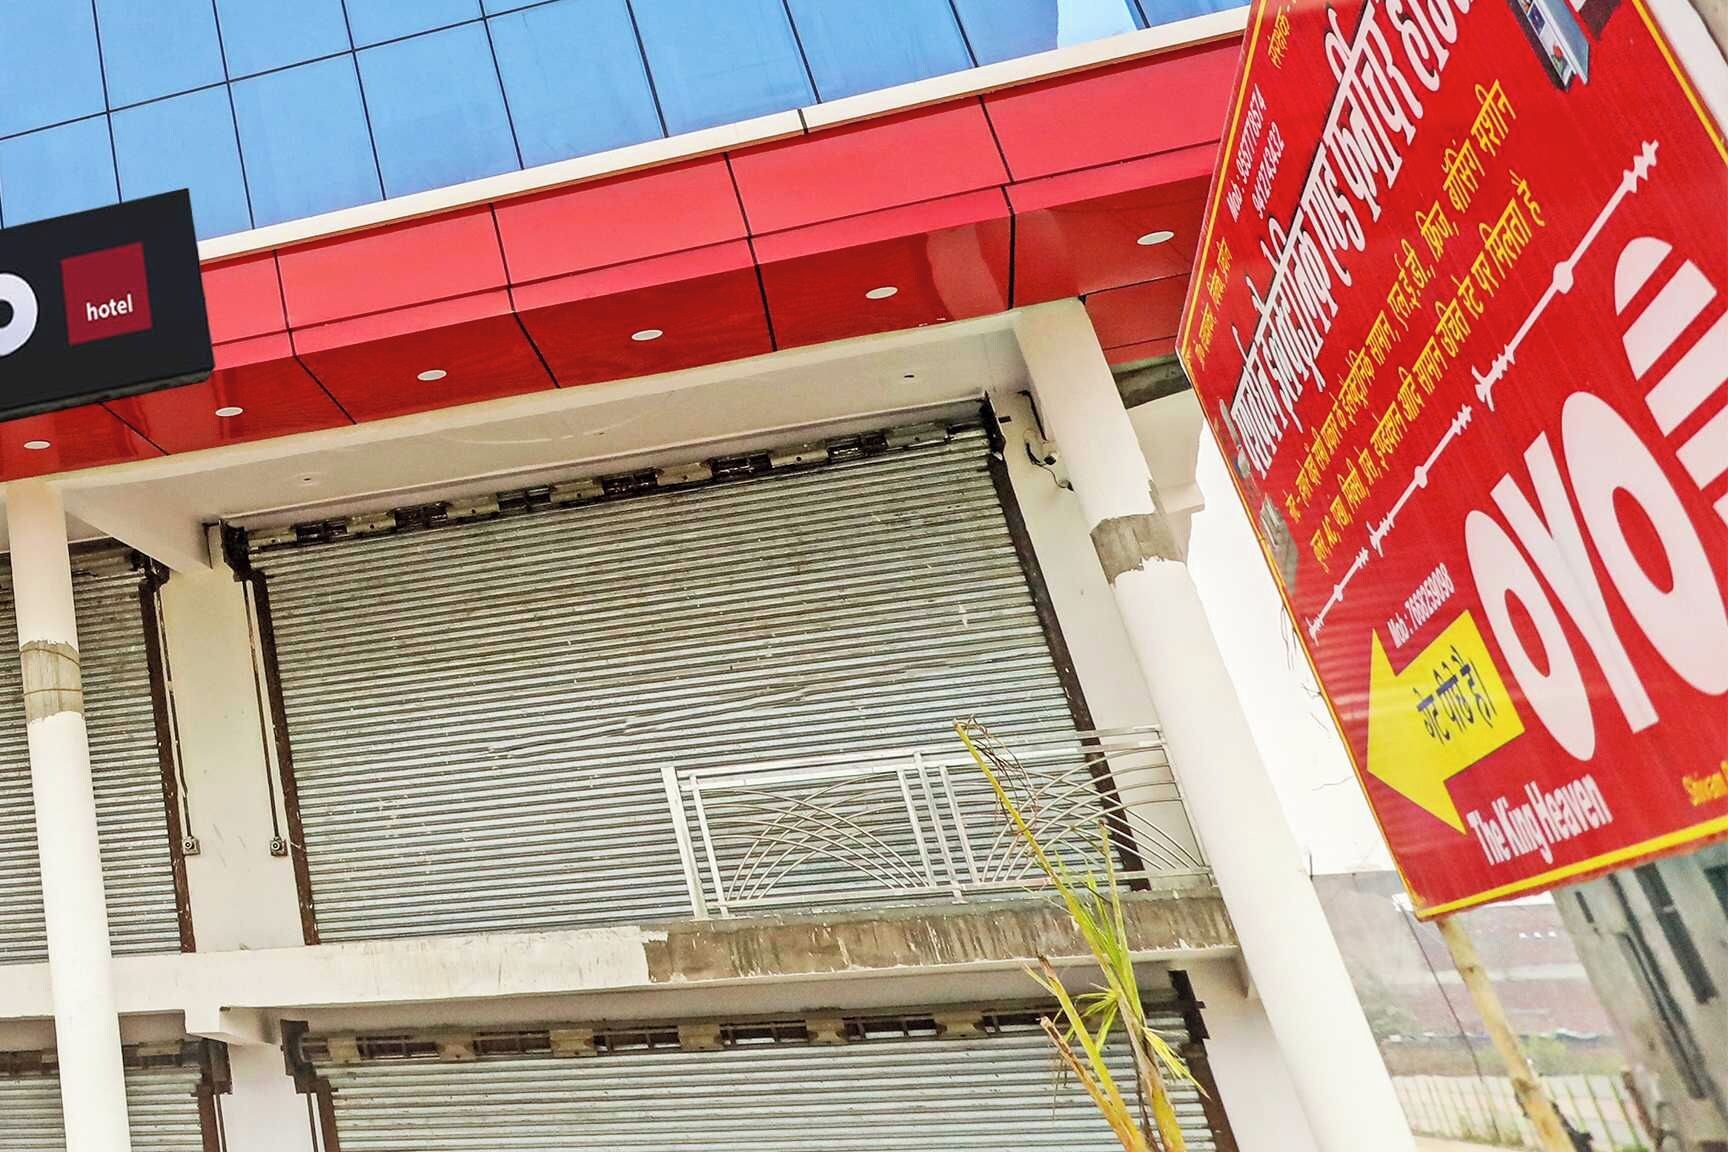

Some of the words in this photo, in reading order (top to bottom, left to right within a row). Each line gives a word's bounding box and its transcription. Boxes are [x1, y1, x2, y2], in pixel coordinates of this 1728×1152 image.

[1268, 6, 1289, 69] संरक्षक
[1323, 0, 1423, 222] फर्नीचर
[1227, 181, 1242, 221] Mob
[1236, 84, 1266, 184] 9557778574
[1252, 122, 1284, 219] 9412743432
[1301, 142, 1365, 286] एण्ड
[1510, 170, 1545, 226] है
[1320, 412, 1342, 455] प्रकार
[1331, 394, 1347, 430] के
[1366, 310, 1400, 365] सामान,
[1416, 200, 1459, 262] फ्रिज,
[1471, 80, 1516, 156] मशीन
[1479, 198, 1532, 278] मिलता
[1451, 275, 1483, 319] रेट
[1471, 251, 1499, 296] पर
[86, 294, 134, 321] hotel
[1435, 298, 1471, 357] उचित
[1398, 367, 1424, 421] आदि
[1412, 336, 1447, 394] सामान
[1231, 326, 1288, 480] यशवर्धन
[1355, 448, 1382, 485] प्रेस,
[1405, 563, 1454, 629] 7668259098
[1465, 391, 1728, 761] OYO
[1414, 689, 1450, 740] गेट
[1467, 810, 1511, 865] The
[1492, 797, 1553, 864] King
[1525, 773, 1614, 844] Heaven
